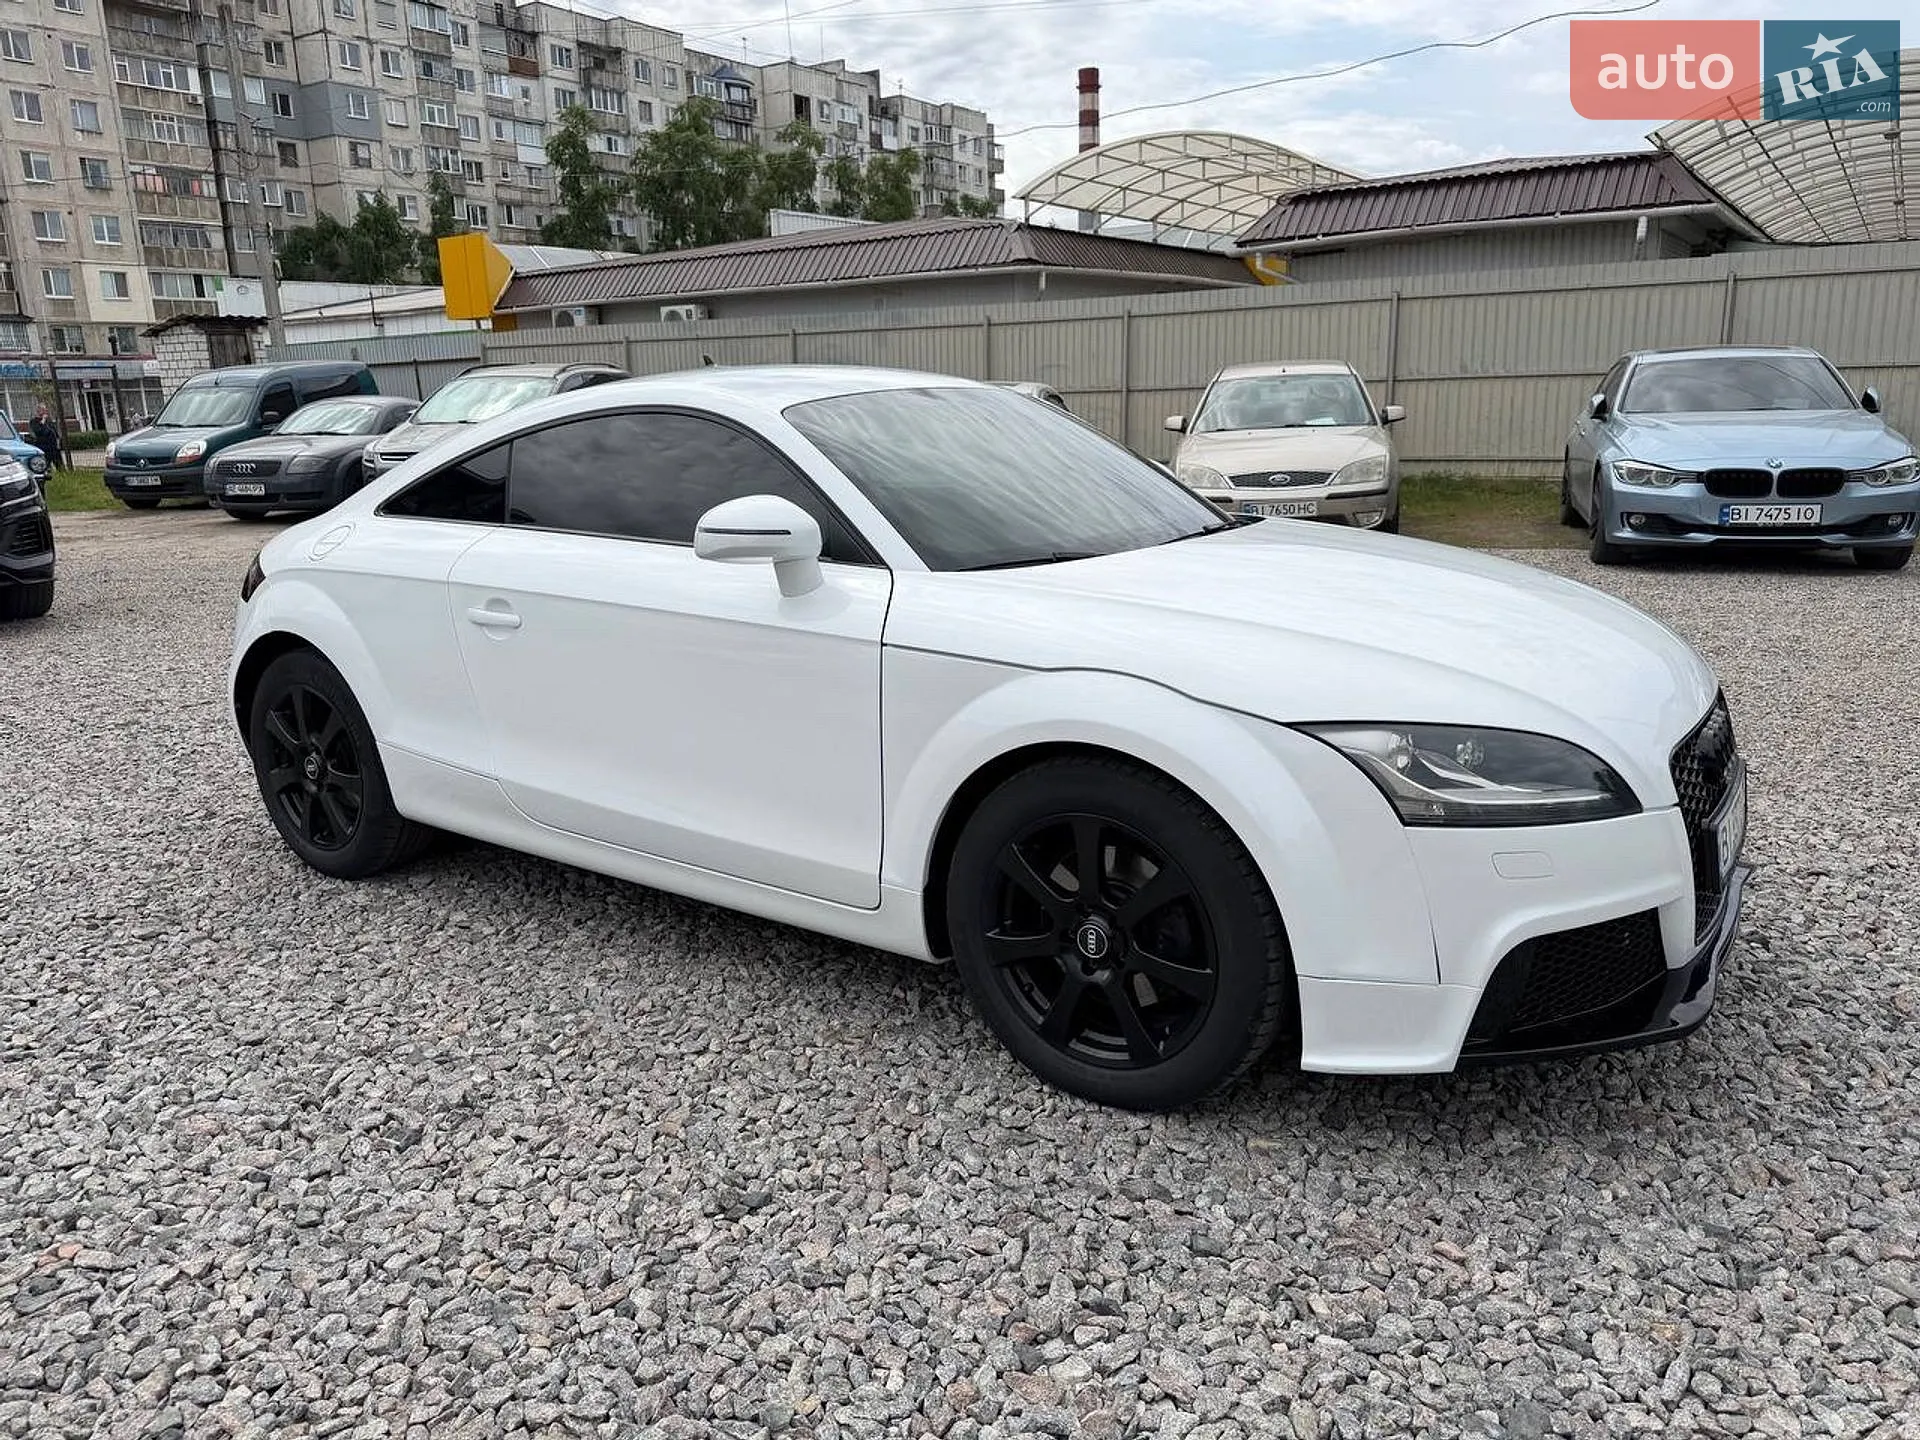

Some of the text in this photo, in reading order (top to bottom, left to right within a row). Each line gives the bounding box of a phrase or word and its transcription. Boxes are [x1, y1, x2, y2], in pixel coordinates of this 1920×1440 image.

[1269, 504, 1296, 515] 7650
[1297, 502, 1316, 514] HC
[1731, 507, 1749, 521] BI
[1755, 507, 1791, 521] 7475
